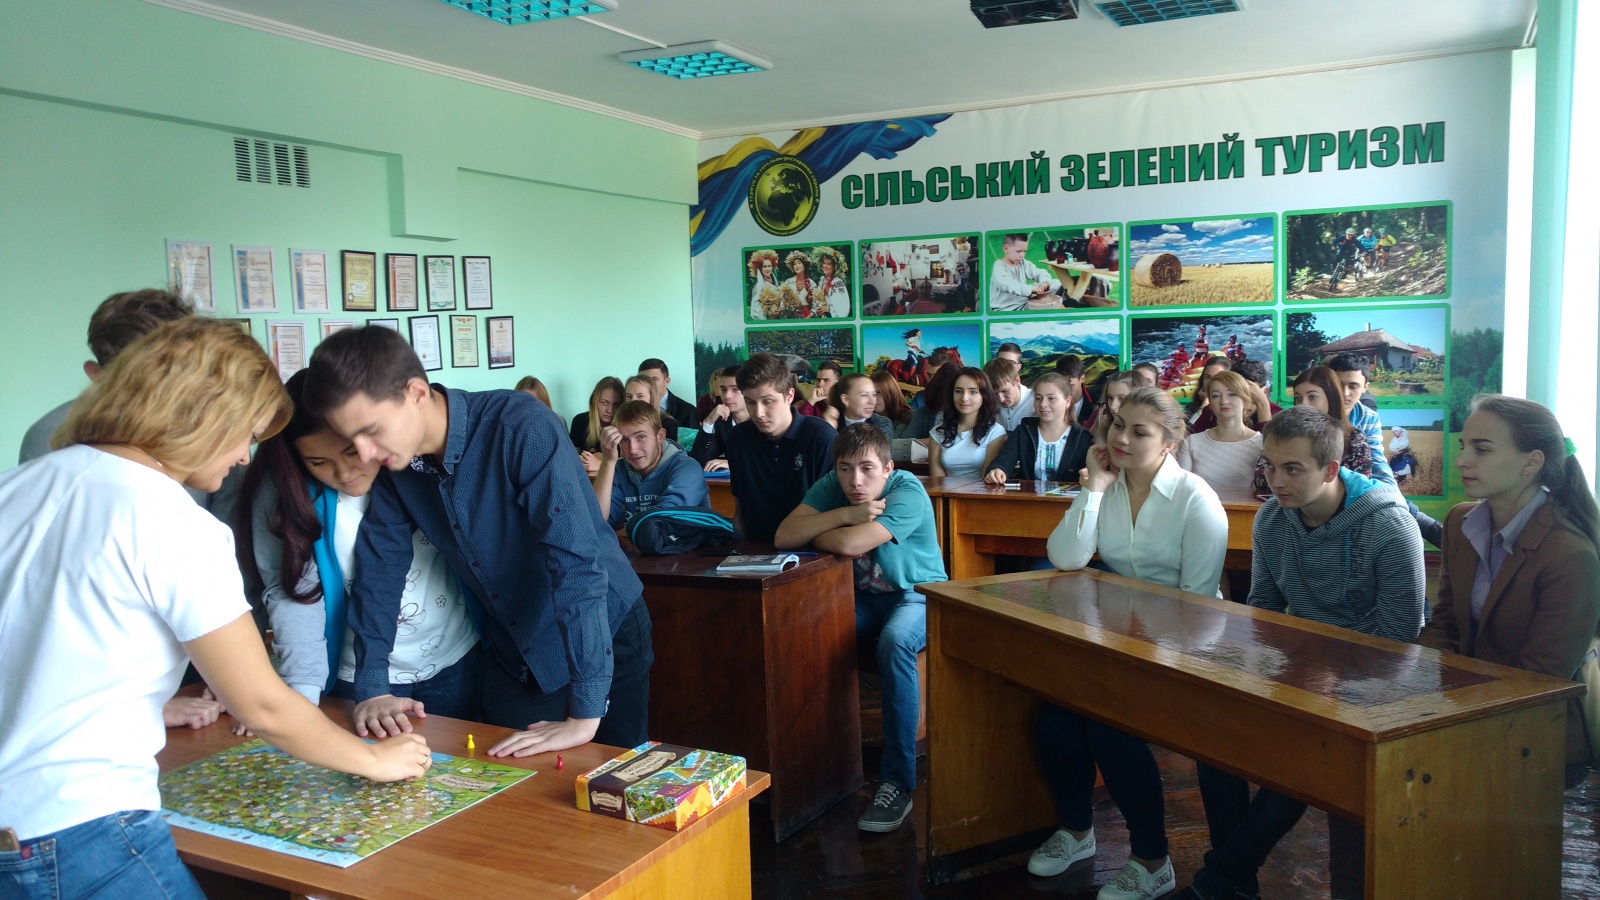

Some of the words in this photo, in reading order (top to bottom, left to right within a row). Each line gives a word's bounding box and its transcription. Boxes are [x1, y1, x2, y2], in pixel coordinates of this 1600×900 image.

[841, 151, 1050, 210] СІЛЬСЬКИЙ
[1060, 133, 1244, 192] ЗЕЛЕНИЙ
[1255, 121, 1445, 176] ТУРИЗМ
